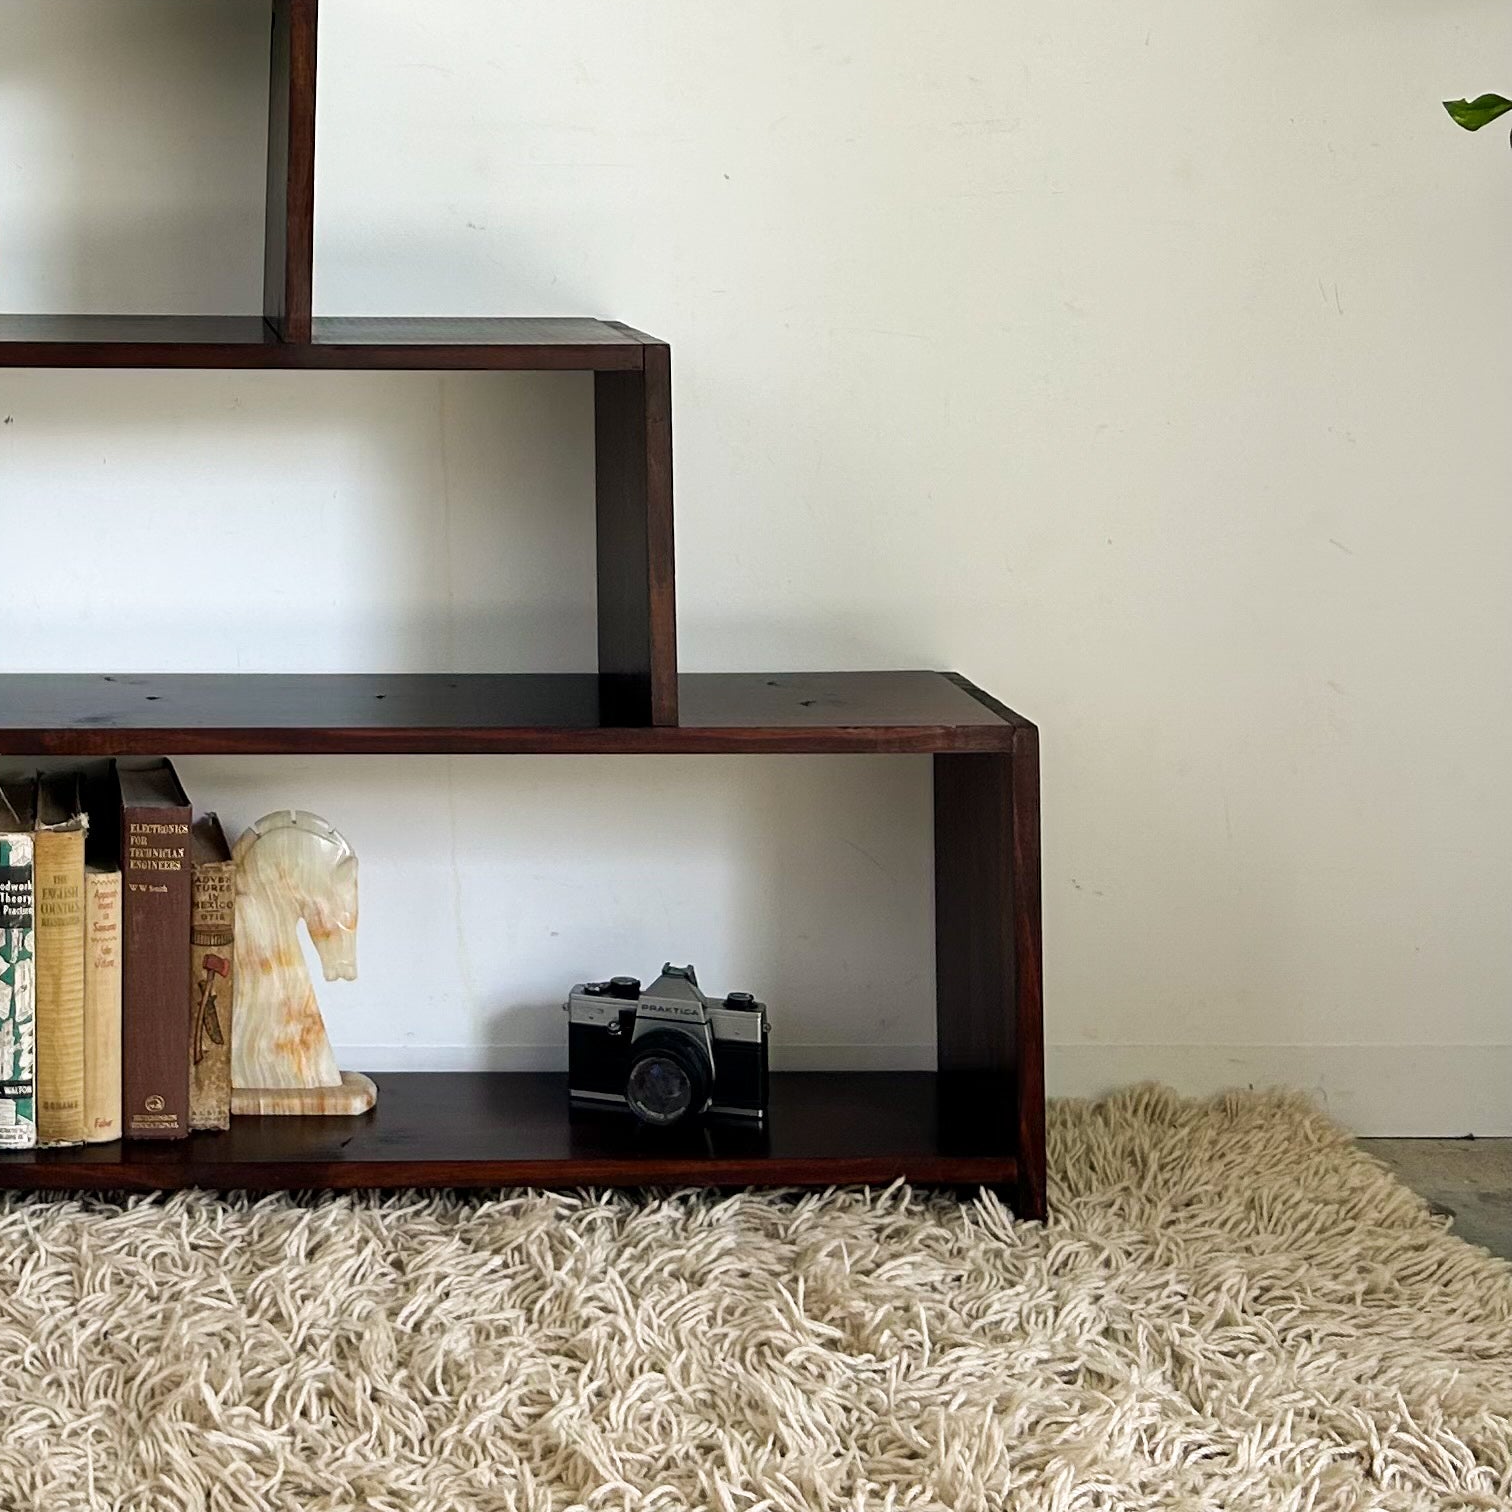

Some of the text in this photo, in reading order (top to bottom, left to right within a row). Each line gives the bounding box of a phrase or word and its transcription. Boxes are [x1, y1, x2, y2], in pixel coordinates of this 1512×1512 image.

[130, 824, 189, 834] ELECTRONICS
[130, 836, 148, 846] FOR
[129, 848, 185, 859] TECHNICIAN
[129, 860, 182, 871] ENGINEERS
[0, 891, 33, 905] Theory
[192, 901, 234, 909] MEXICO
[641, 1004, 699, 1016] PRAKTICA
